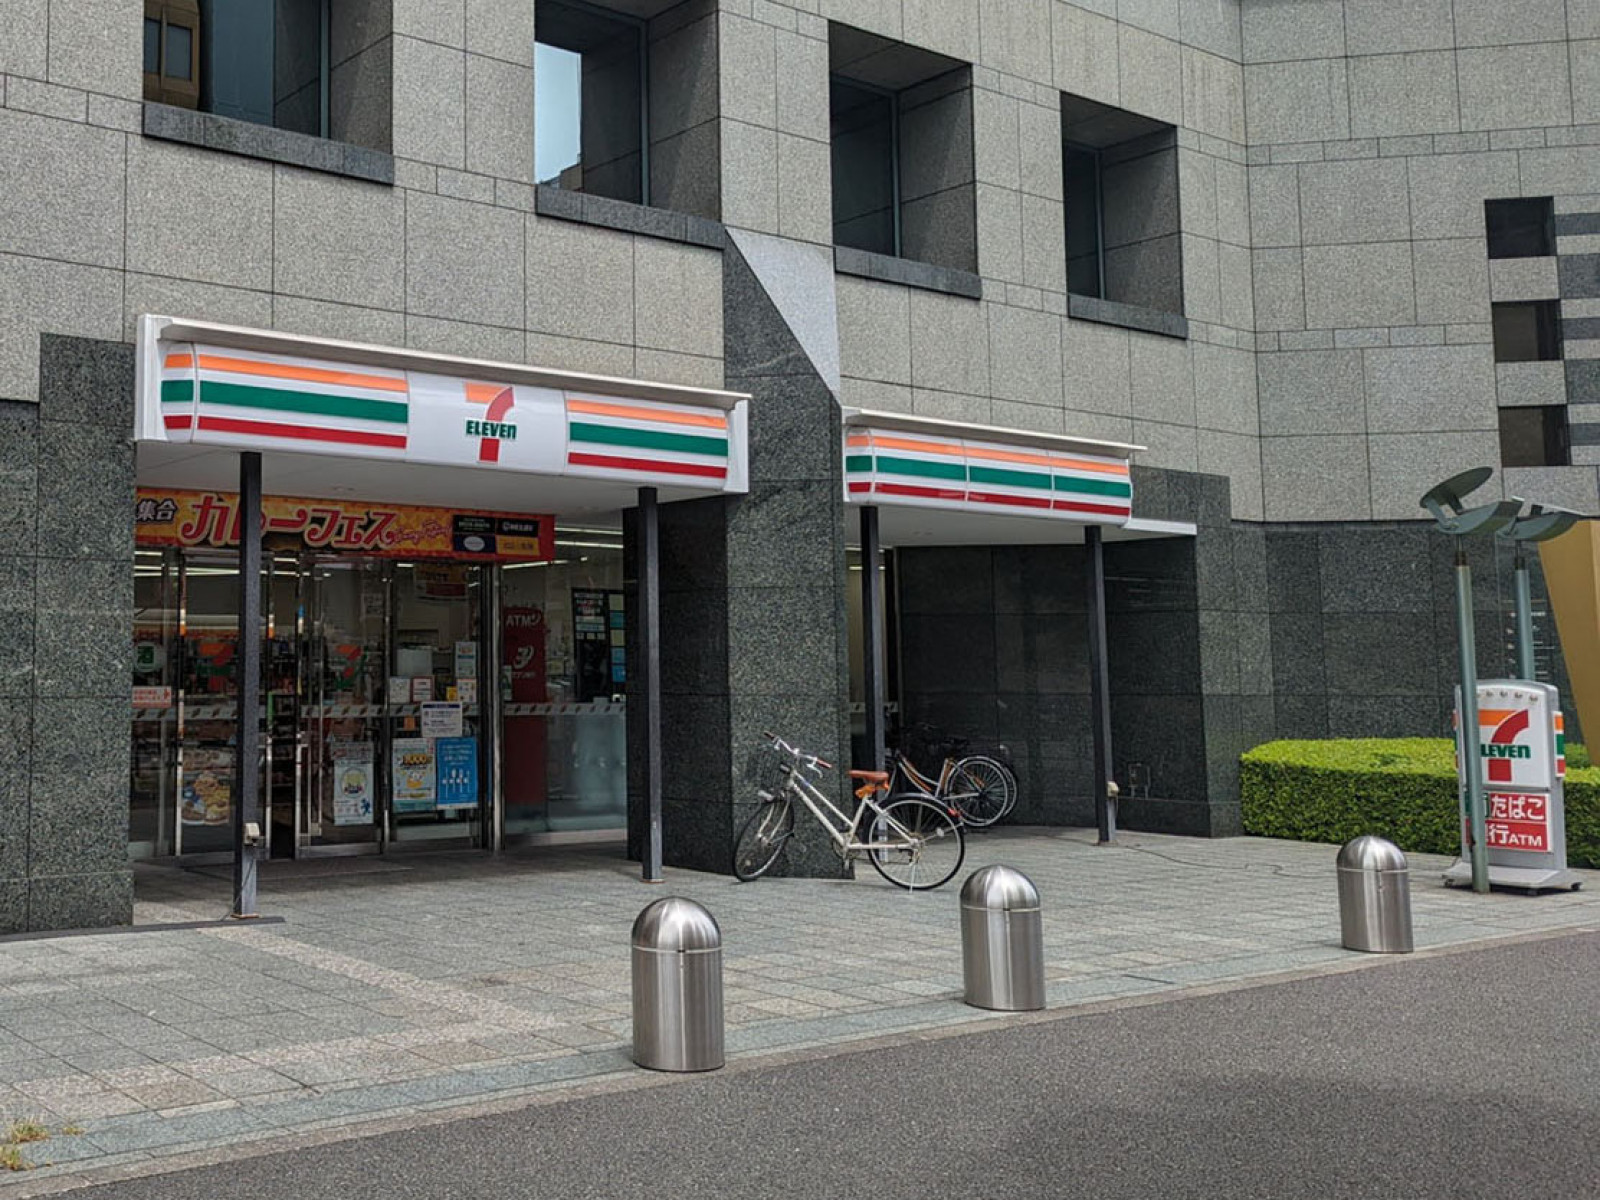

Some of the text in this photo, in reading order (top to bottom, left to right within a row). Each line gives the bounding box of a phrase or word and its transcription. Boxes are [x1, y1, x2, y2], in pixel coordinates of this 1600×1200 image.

[464, 383, 515, 461] 7
[506, 614, 531, 628] ATM
[1491, 795, 1545, 820] たばこ
[1486, 824, 1542, 847] 行ATM
